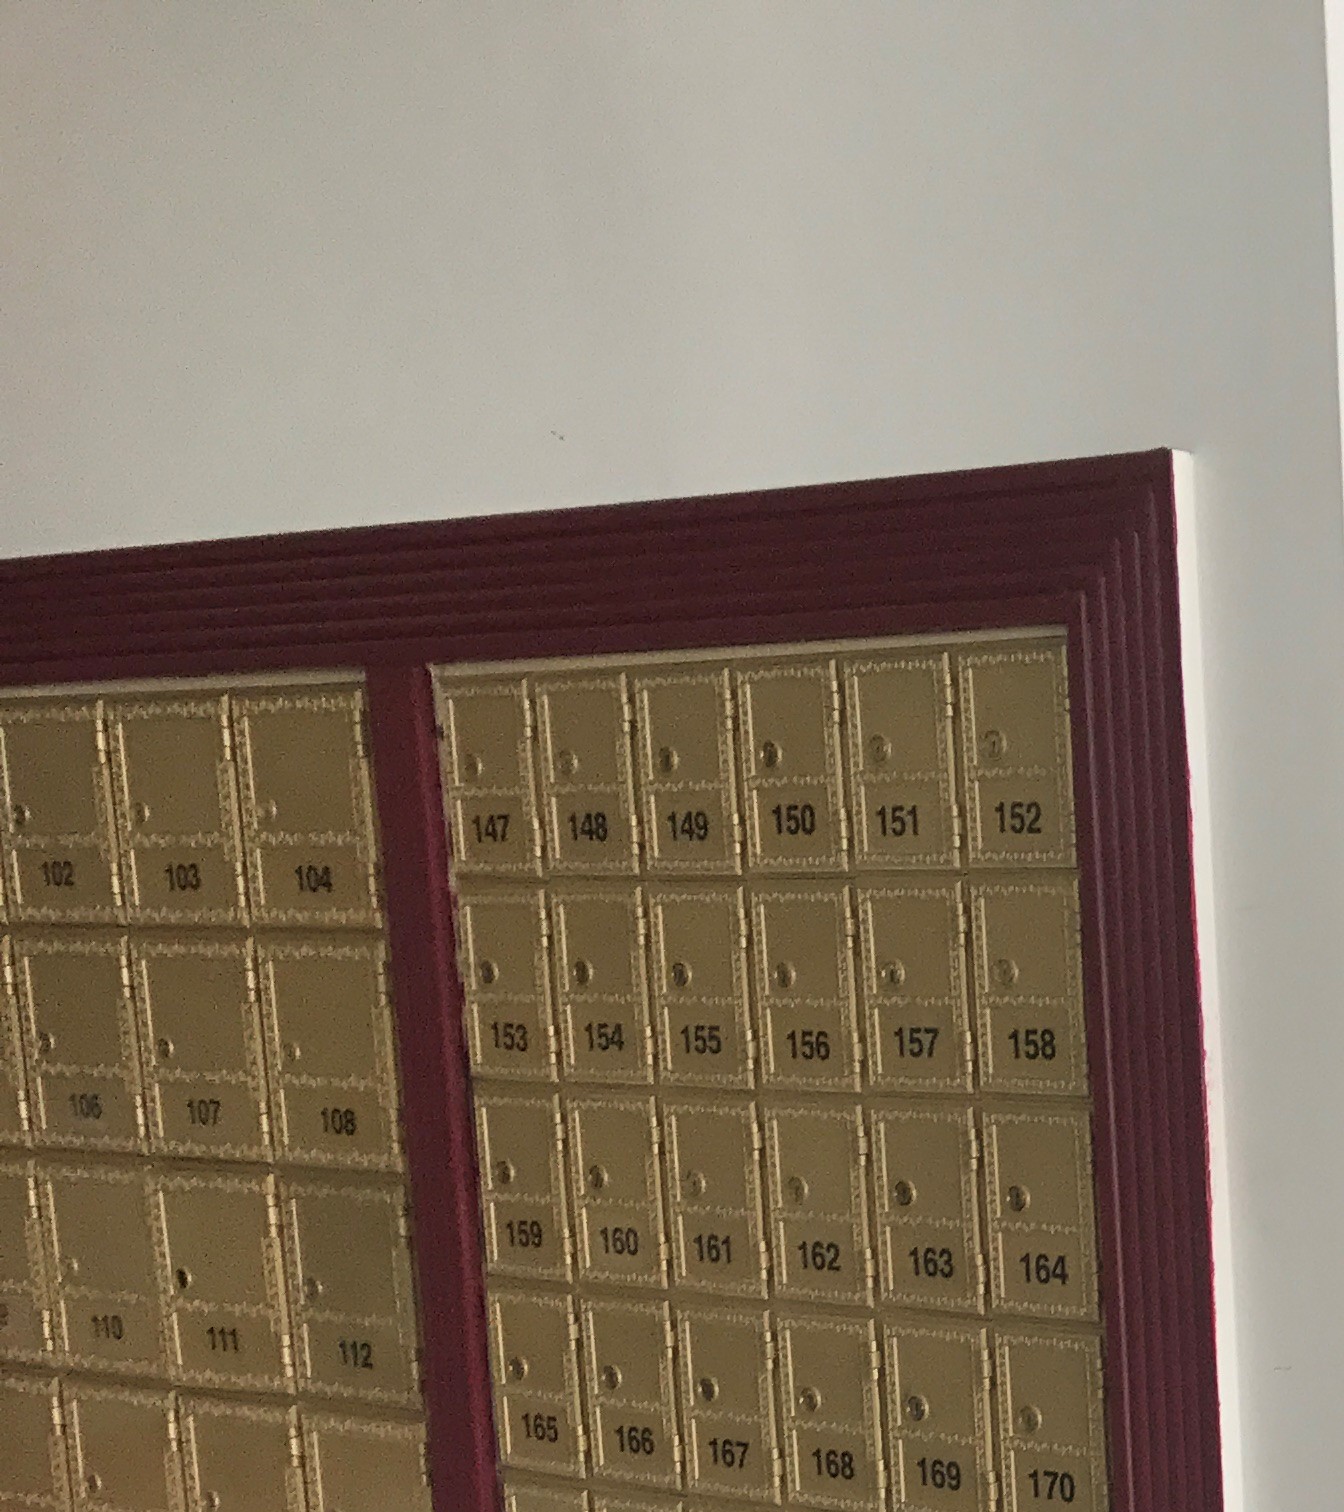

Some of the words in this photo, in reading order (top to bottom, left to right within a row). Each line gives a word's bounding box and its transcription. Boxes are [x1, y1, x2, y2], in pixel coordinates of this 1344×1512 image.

[473, 814, 510, 843] 147
[569, 812, 608, 842] 148
[668, 811, 709, 841] 149
[772, 804, 815, 835] 150
[876, 805, 918, 836] 151
[995, 802, 1041, 834] 152
[42, 860, 74, 887] 102
[165, 863, 201, 891] 103
[295, 865, 332, 893] 104
[491, 1022, 528, 1052] 153
[585, 1023, 624, 1051] 154
[681, 1025, 721, 1054] 155
[787, 1030, 830, 1061] 156
[894, 1027, 939, 1058] 157
[1009, 1029, 1056, 1060] 158
[69, 1093, 102, 1119] 106
[187, 1099, 221, 1125] 107
[321, 1108, 356, 1136] 108
[506, 1220, 542, 1248] 159
[600, 1227, 639, 1256] 160
[694, 1234, 731, 1264] 161
[798, 1241, 841, 1272] 162
[910, 1247, 954, 1279] 163
[1020, 1253, 1068, 1285] 164
[91, 1315, 123, 1340] 110
[207, 1327, 239, 1352] 111
[339, 1341, 373, 1369] 112
[522, 1413, 558, 1443] 165
[615, 1426, 654, 1455] 166
[709, 1438, 749, 1468] 167
[812, 1448, 855, 1480] 168
[917, 1458, 961, 1491] 169
[1029, 1470, 1075, 1503] 170
